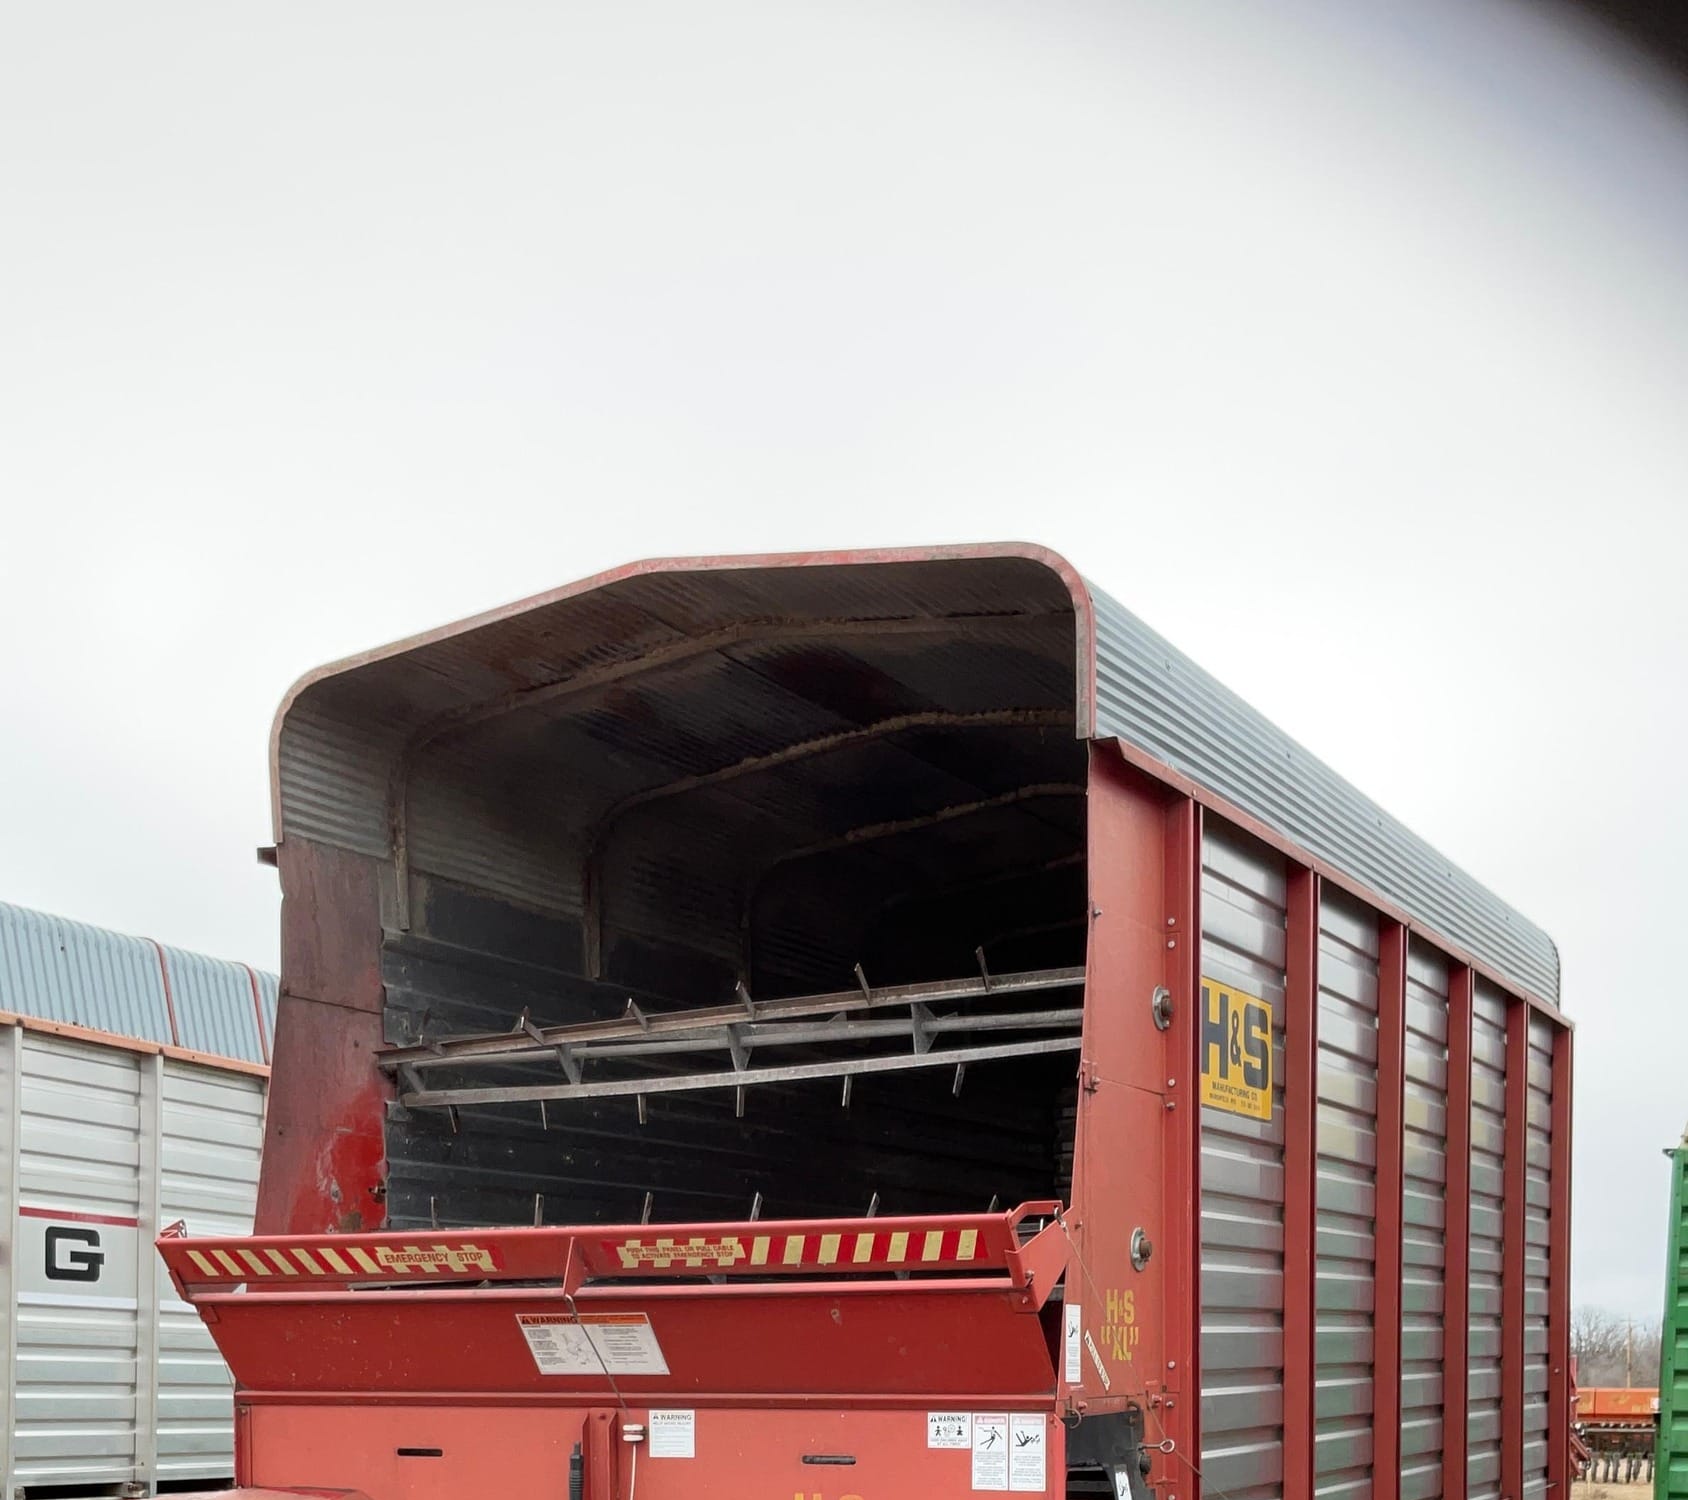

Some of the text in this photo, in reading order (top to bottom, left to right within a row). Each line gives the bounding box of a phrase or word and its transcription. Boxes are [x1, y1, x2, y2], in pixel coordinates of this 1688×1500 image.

[1201, 985, 1269, 1091] H&S
[45, 1226, 105, 1282] G
[384, 1251, 483, 1264] EMERGENCY STOP
[1106, 1289, 1135, 1325] H&S
